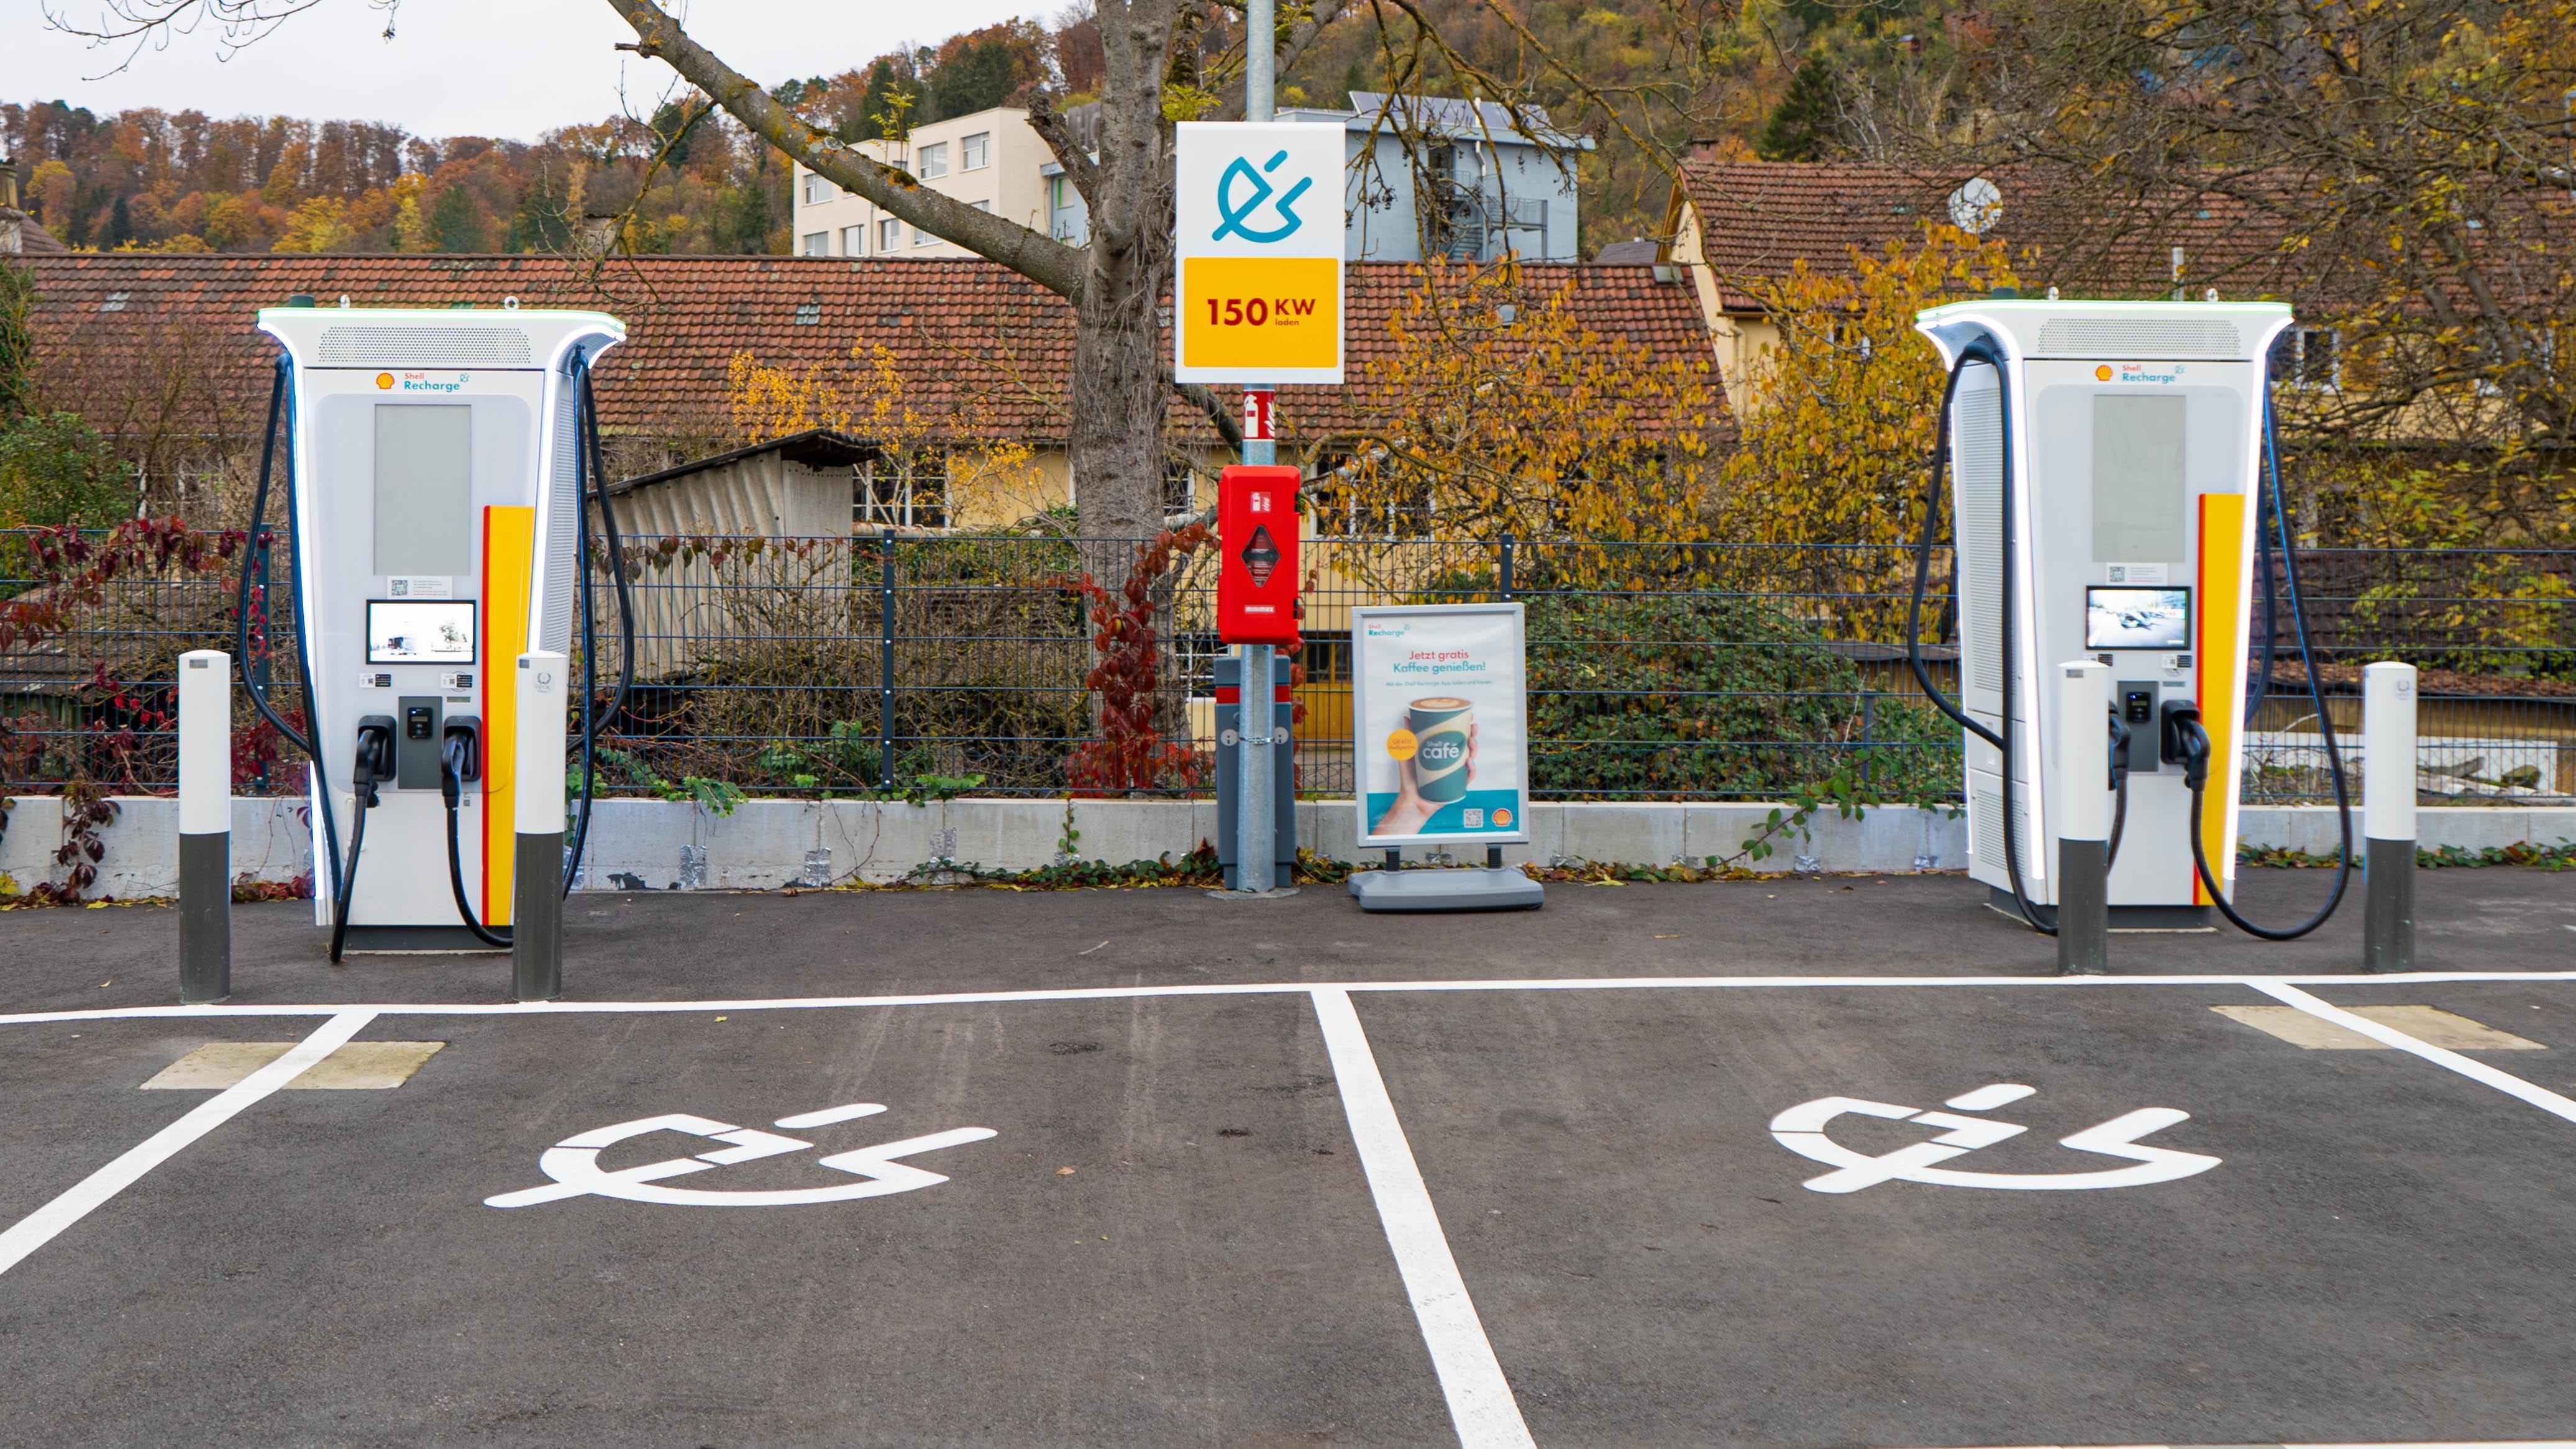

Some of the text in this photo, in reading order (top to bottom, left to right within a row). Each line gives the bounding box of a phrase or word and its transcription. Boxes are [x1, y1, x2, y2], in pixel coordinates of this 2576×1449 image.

[1207, 298, 1316, 326] 150 KW
[2122, 372, 2175, 384] Recharge
[404, 380, 460, 393] Recharge
[1368, 629, 1405, 638] Recharge
[1409, 649, 1469, 662] Jetzt gratis
[1393, 661, 1486, 675] Kaffee genießen!
[1423, 742, 1459, 759] café
